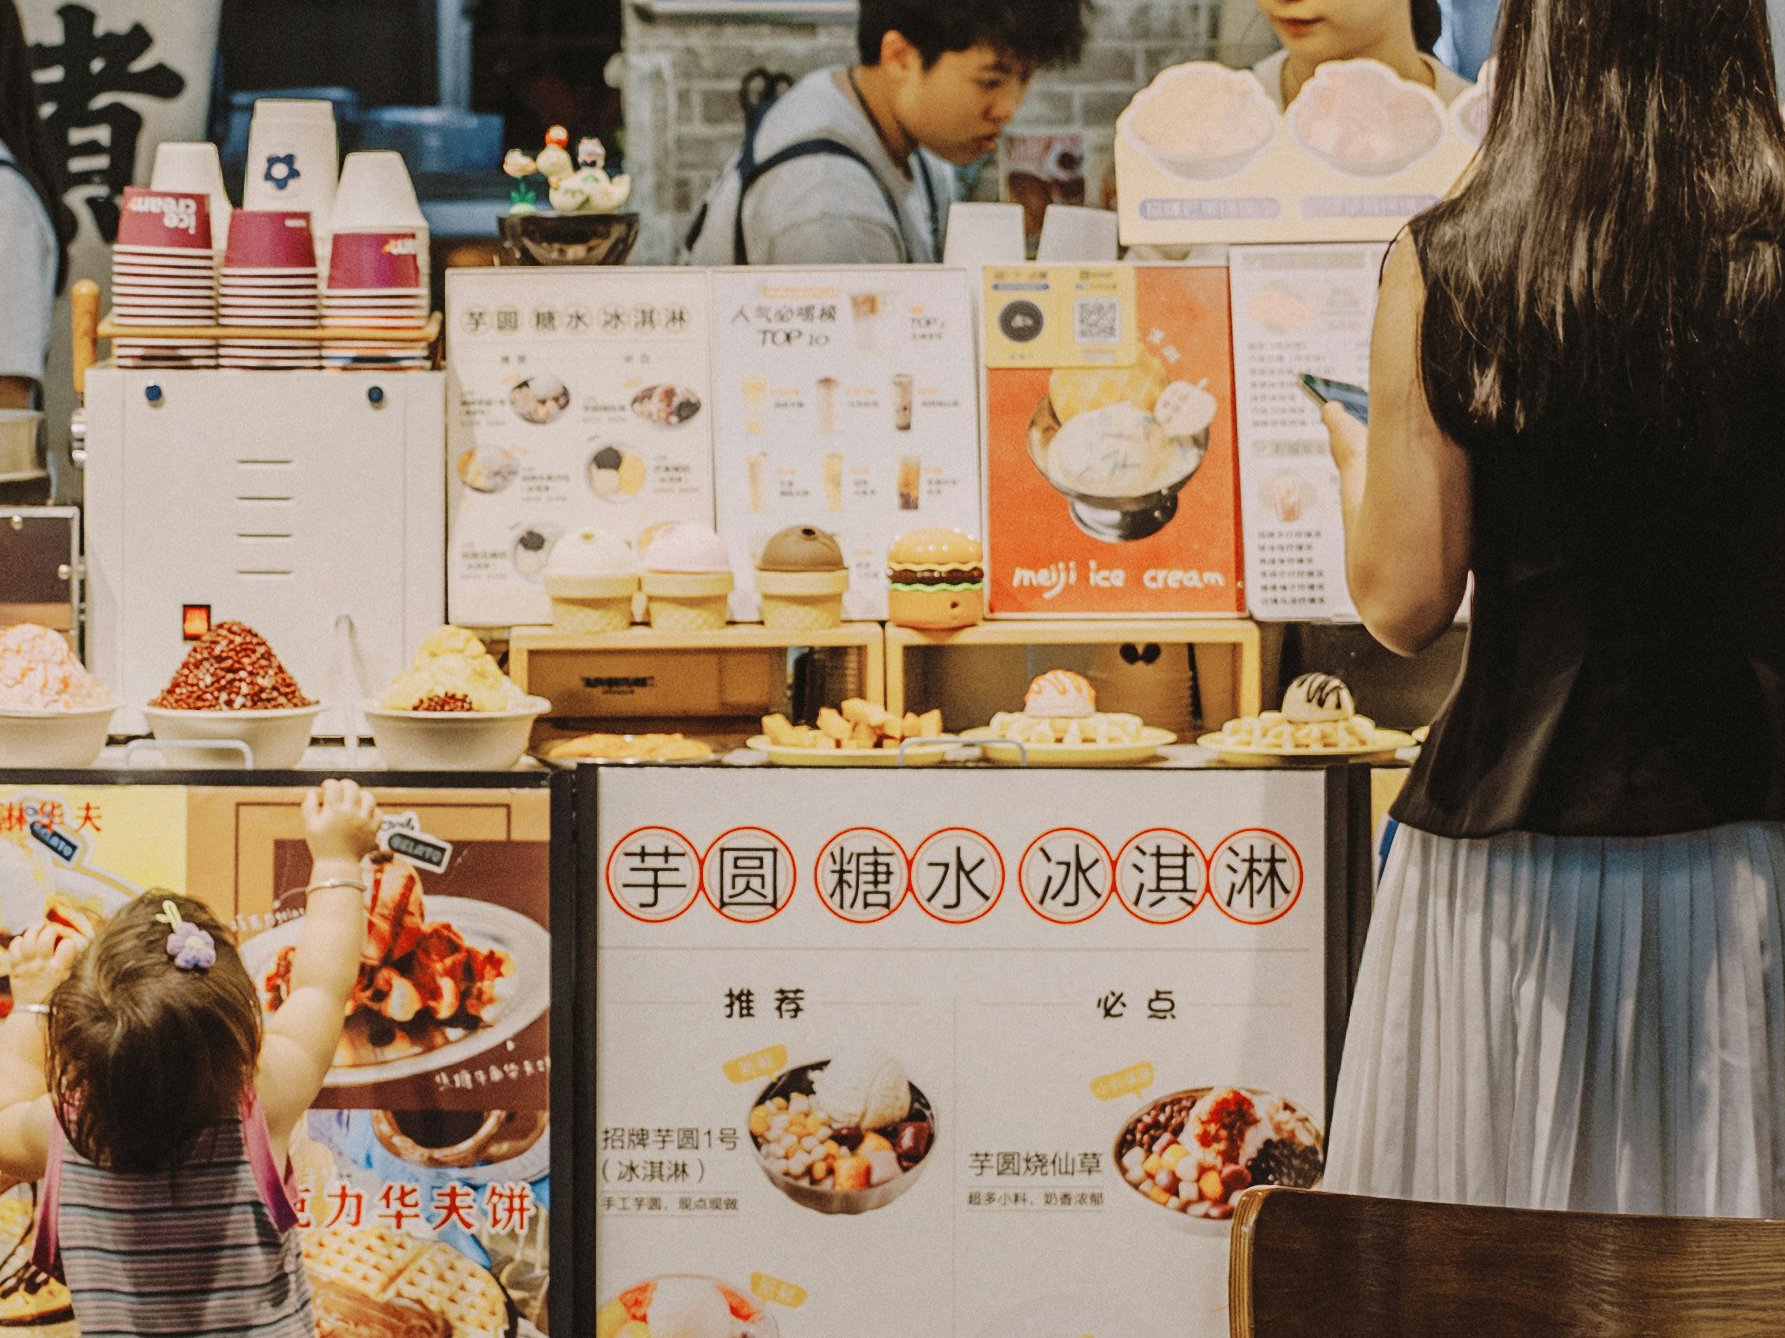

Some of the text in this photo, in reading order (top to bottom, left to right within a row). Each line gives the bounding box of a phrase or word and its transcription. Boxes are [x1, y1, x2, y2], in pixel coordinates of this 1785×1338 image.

[163, 213, 197, 234] ice
[757, 329, 802, 347] TOP
[1013, 559, 1225, 600] meiji ice cream
[725, 987, 806, 1020] 推荐
[1096, 989, 1177, 1020] 必点
[602, 1126, 740, 1151] 招牌芋圆1号
[968, 1151, 1104, 1178] 芋圆烧仙草
